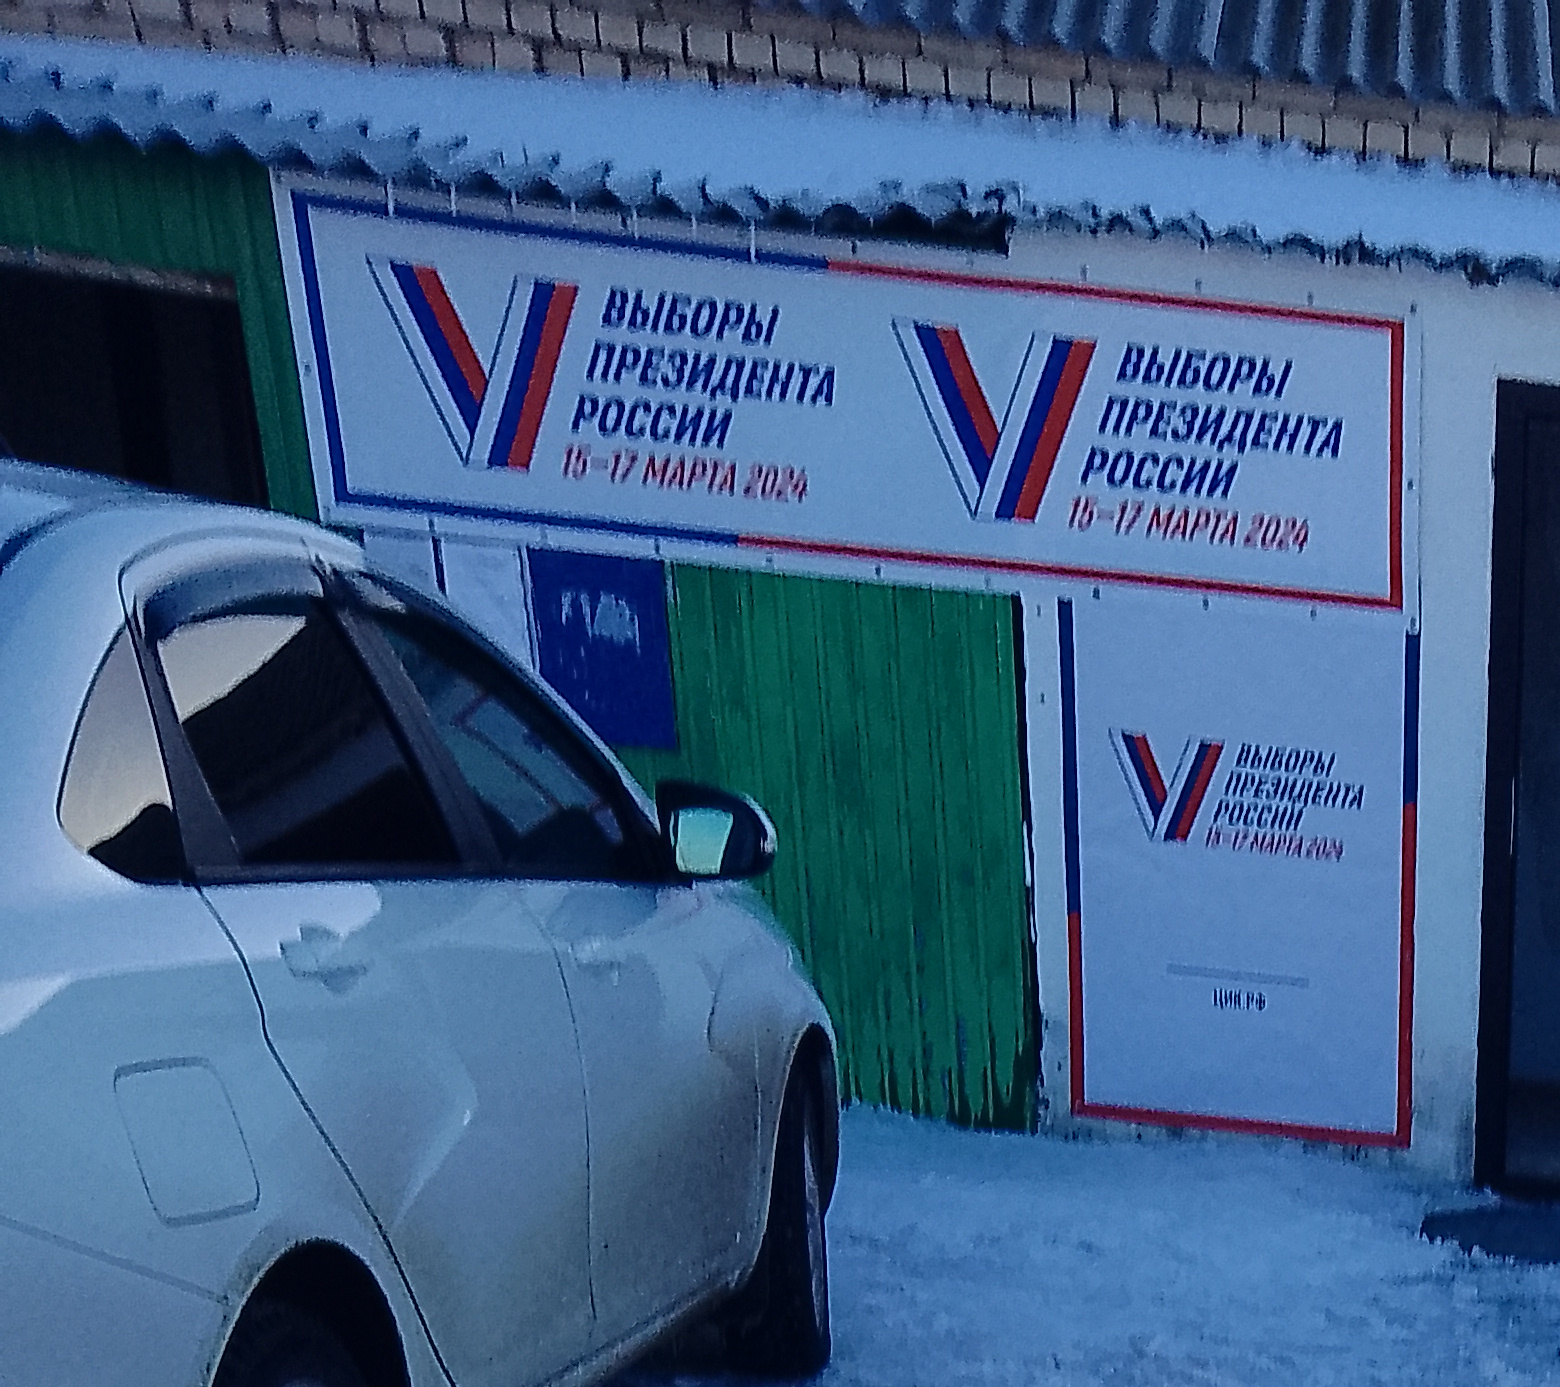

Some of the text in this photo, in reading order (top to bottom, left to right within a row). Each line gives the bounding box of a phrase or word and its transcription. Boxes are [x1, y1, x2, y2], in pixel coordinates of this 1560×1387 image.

[601, 286, 780, 346] ВЫБОРЫ
[585, 340, 835, 406] ПРЕЗИДЕНТА
[1116, 342, 1293, 400] ВЫБОРЫ
[571, 395, 733, 449] РОССИИ
[1098, 394, 1344, 459] ПРЕЗИДЕНТА
[641, 451, 737, 497] МАРТА
[742, 462, 810, 504] 2024
[1080, 445, 1239, 499] РОССИИ
[1146, 501, 1239, 548] МАРТА
[1243, 512, 1309, 554] 2024
[1236, 742, 1336, 778] ВЫБОРЫ
[1212, 799, 1304, 831] РОССИИ
[1224, 770, 1365, 810] ПРЕЗИДЕНТА
[1250, 831, 1303, 858] МАРТА
[1213, 988, 1266, 1011] ЦИК.РФ
